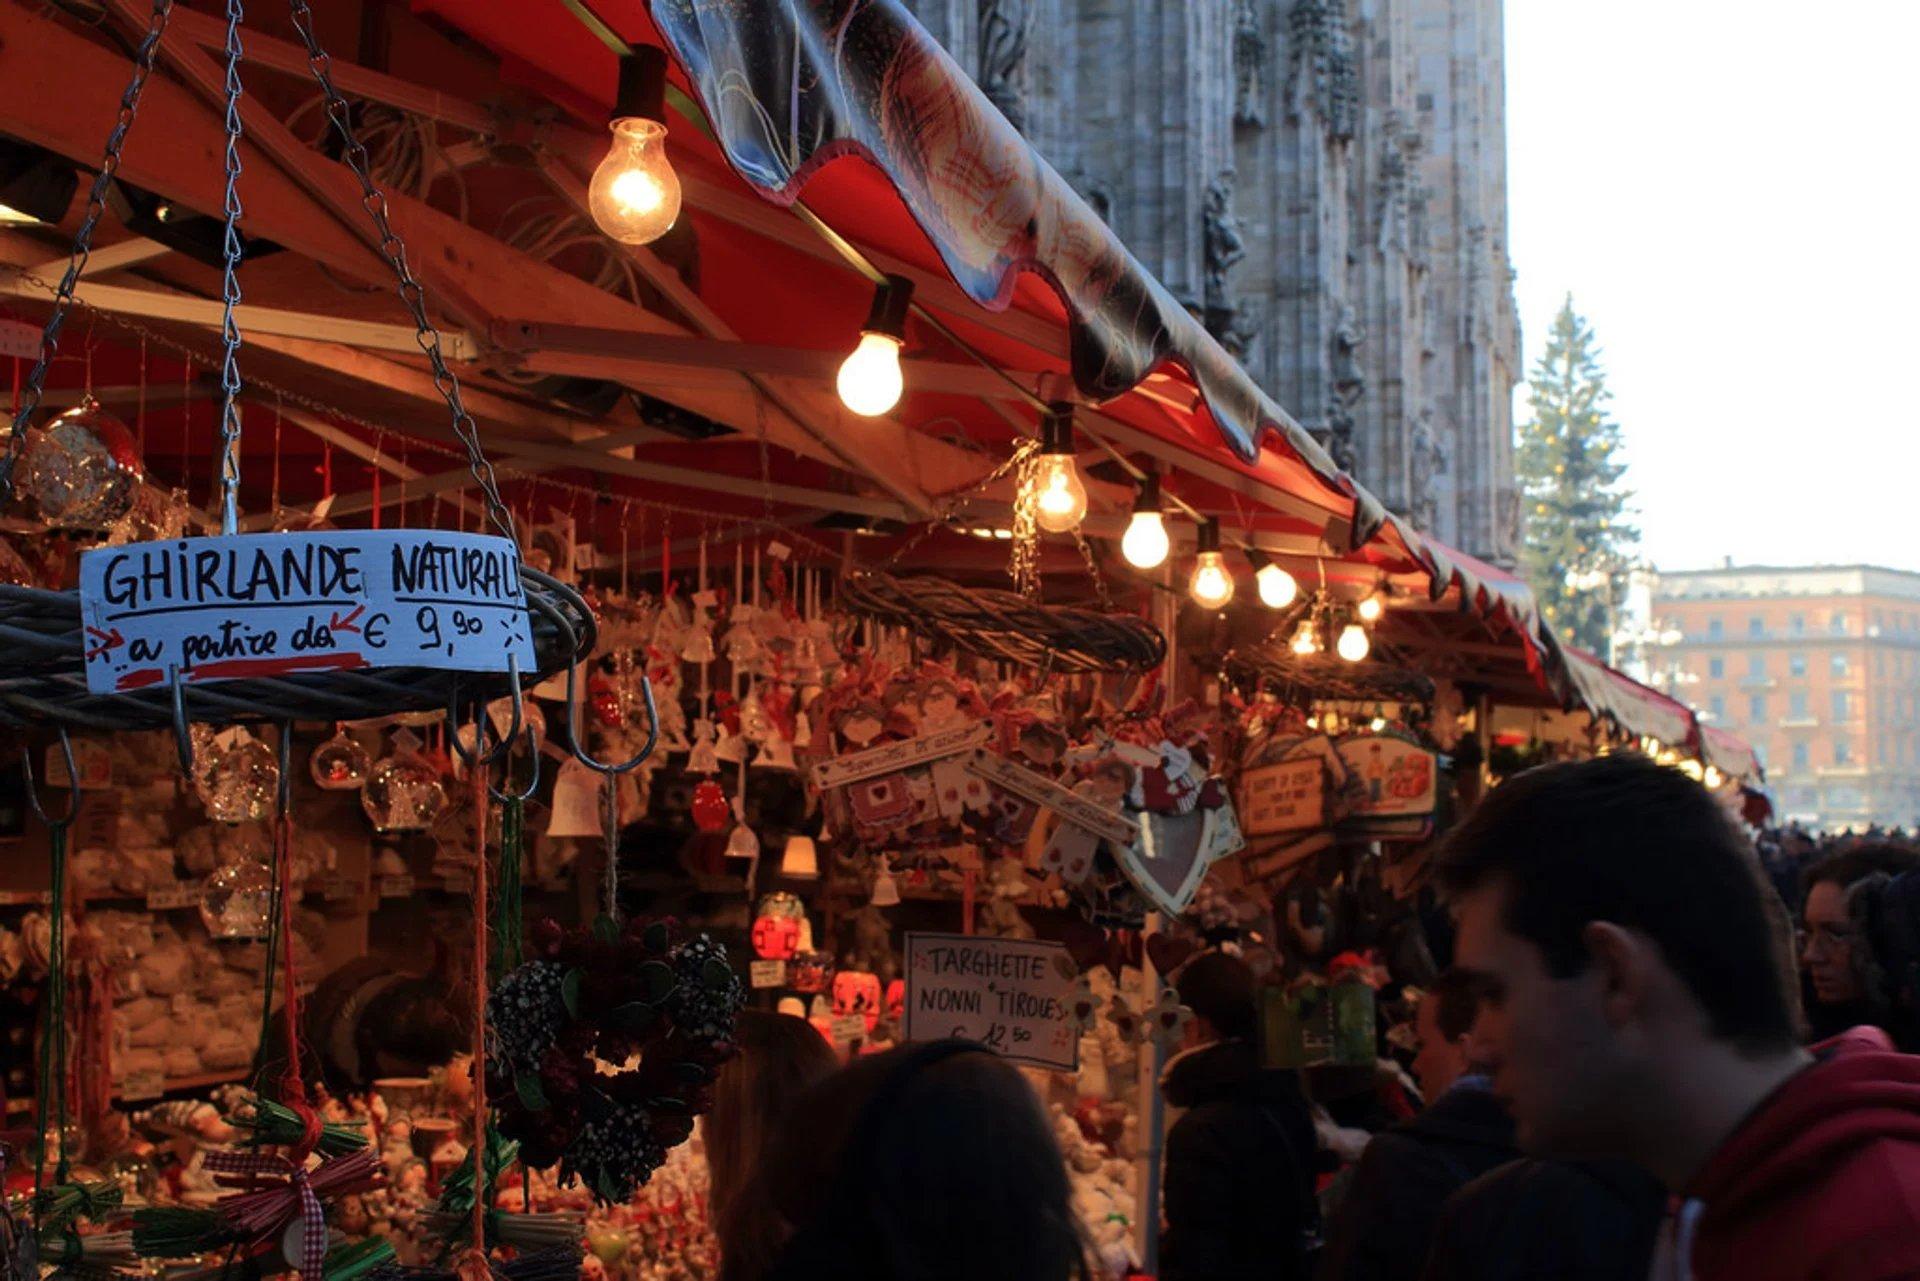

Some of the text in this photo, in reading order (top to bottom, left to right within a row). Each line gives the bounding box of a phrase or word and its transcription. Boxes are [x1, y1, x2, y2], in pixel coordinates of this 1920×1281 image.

[128, 637, 164, 663] a
[183, 619, 278, 673] partire
[290, 615, 337, 652] da
[363, 612, 391, 649] €
[927, 947, 1048, 979] TARGHETTE
[920, 986, 982, 1015] NONNI
